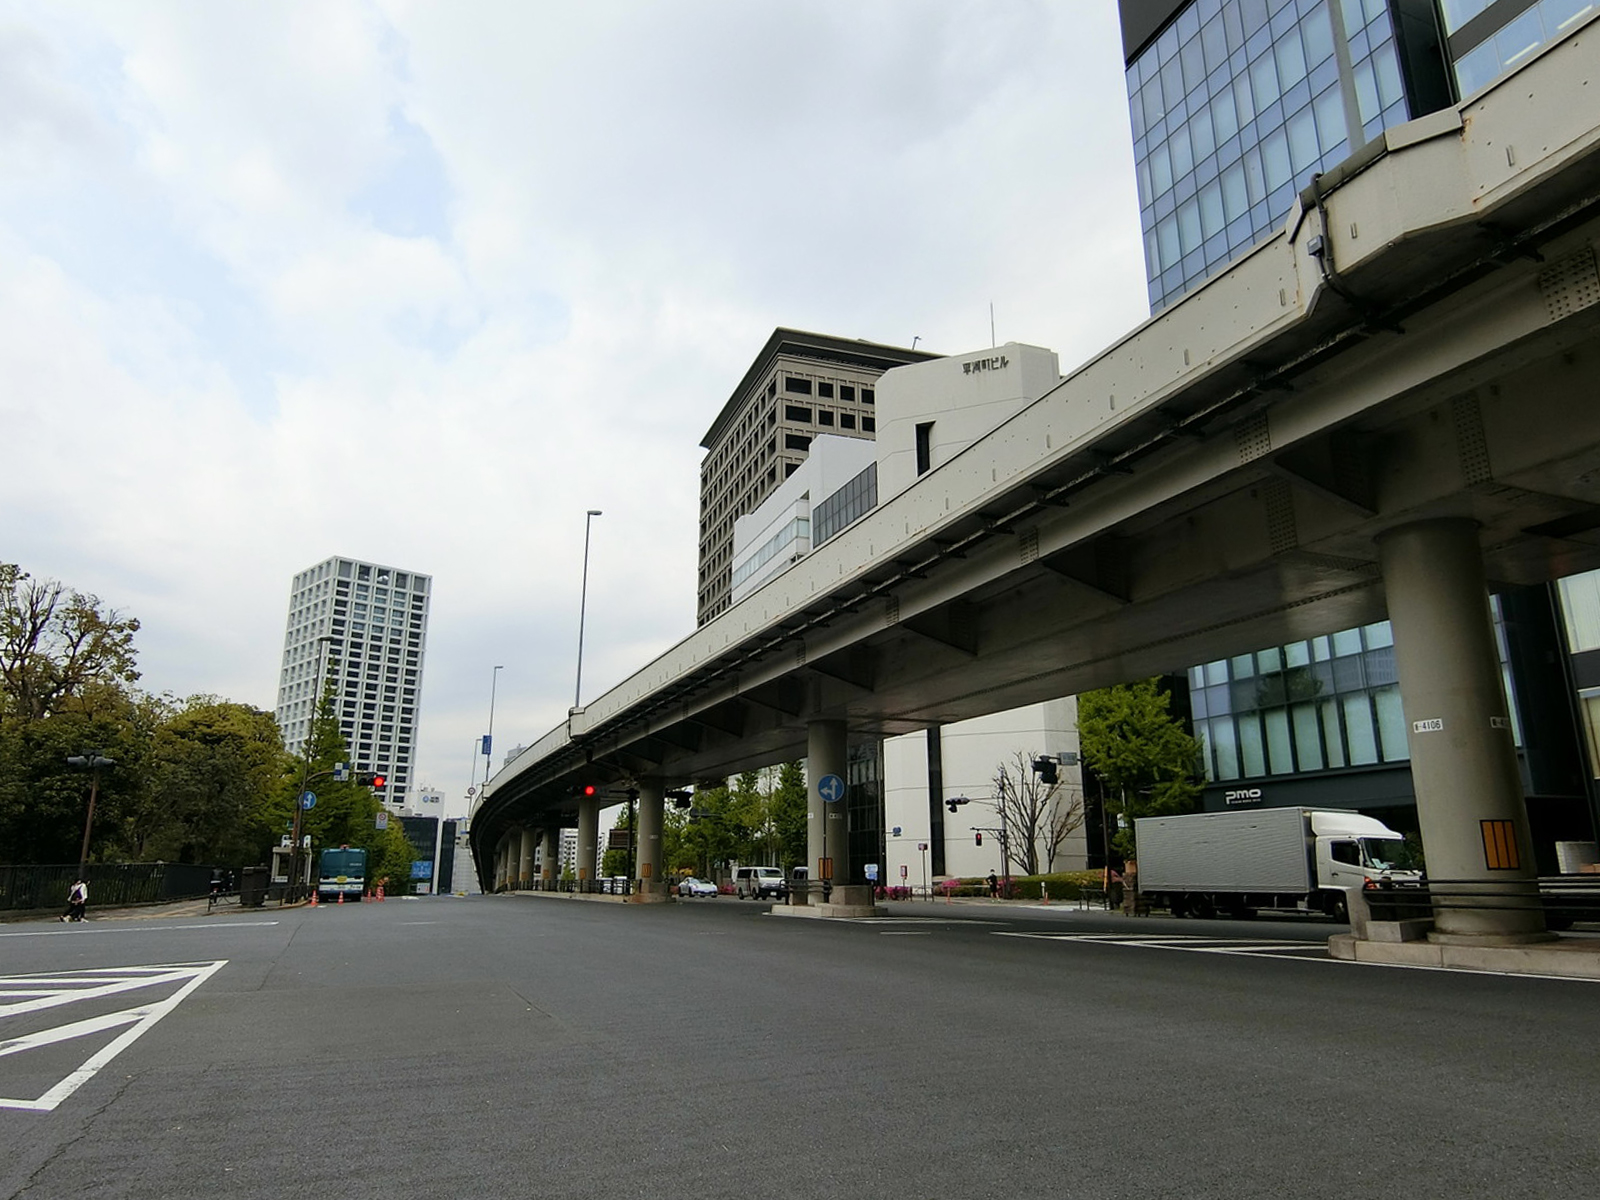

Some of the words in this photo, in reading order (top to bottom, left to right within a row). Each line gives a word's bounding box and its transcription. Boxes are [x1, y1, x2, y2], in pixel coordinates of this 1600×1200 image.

[962, 355, 1009, 375] 平河町ビル
